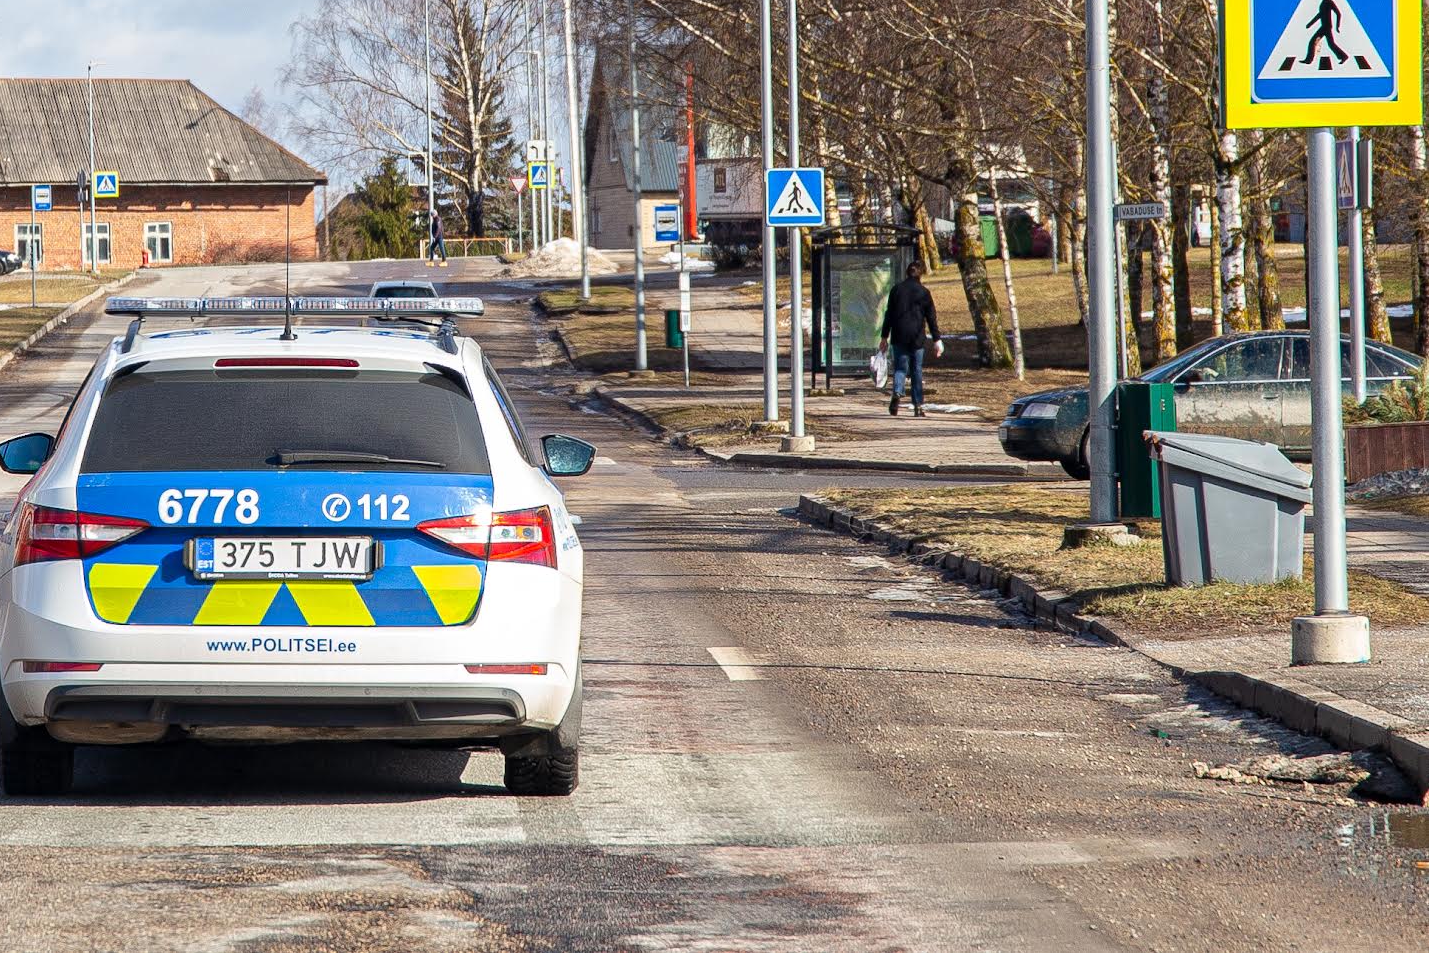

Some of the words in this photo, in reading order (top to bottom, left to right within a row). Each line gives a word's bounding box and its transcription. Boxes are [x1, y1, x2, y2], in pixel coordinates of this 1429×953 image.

[158, 488, 260, 525] 6778
[357, 493, 410, 522] 112
[197, 559, 214, 569] EST
[221, 541, 275, 568] 375
[290, 542, 360, 569] TJW
[206, 638, 357, 653] www.POLITSEI.ee
